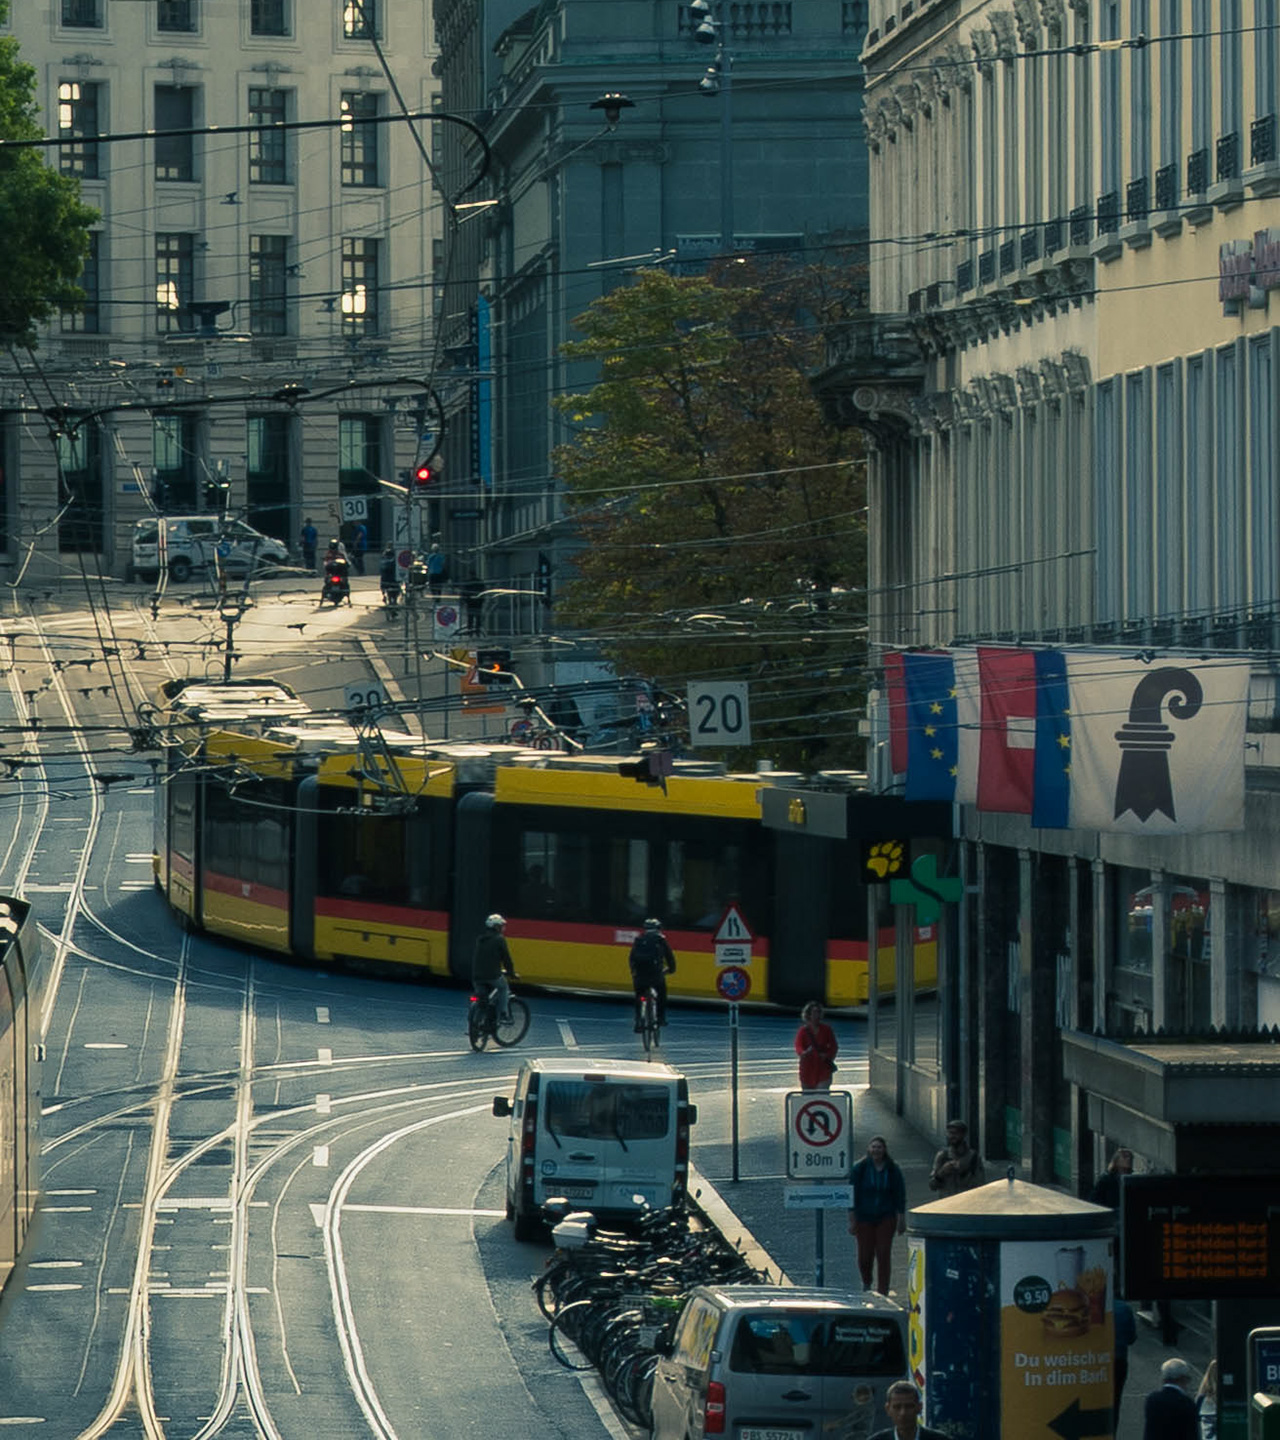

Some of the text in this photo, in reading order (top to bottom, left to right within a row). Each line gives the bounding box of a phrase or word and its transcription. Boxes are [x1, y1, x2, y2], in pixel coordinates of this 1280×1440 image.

[345, 500, 365, 517] 30
[696, 693, 743, 735] 20
[805, 1152, 833, 1167] 80m
[1024, 1289, 1049, 1306] 9.50
[1014, 1352, 1040, 1368] Du
[1044, 1349, 1096, 1367] weisch
[1024, 1370, 1041, 1386] In
[1047, 1369, 1077, 1386] dim
